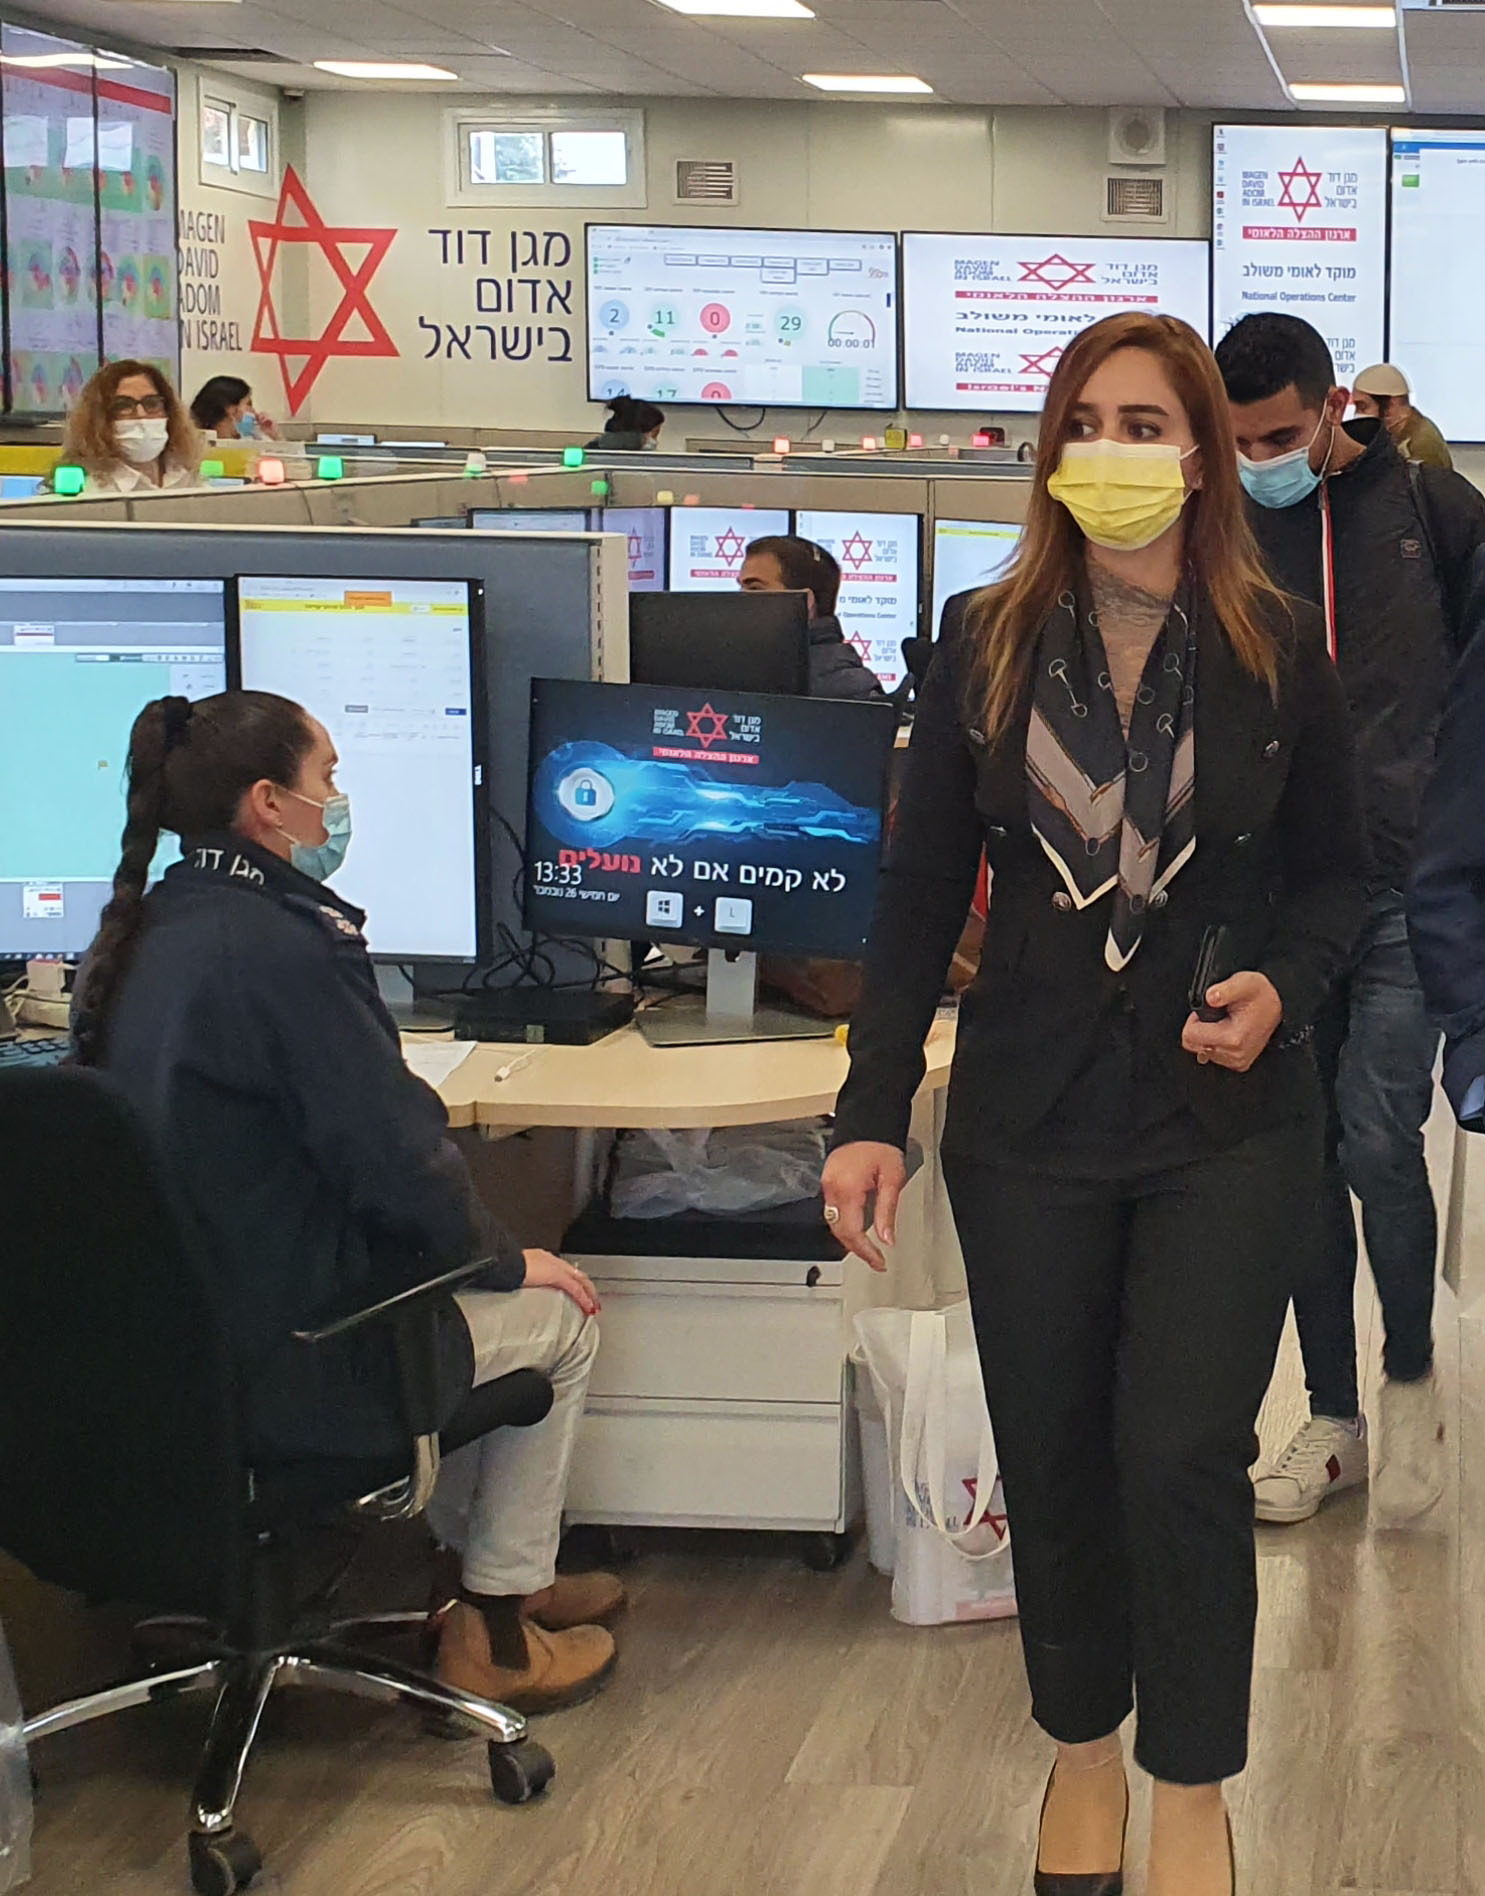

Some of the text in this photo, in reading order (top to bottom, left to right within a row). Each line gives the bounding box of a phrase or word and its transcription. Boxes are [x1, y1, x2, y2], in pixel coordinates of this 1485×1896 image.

[428, 229, 571, 272] מגן דוד
[1242, 262, 1356, 281] מוקד לאומי משולב
[476, 278, 572, 315] אדום
[1242, 291, 1357, 303] National Operations Center
[610, 308, 620, 323] 2
[655, 310, 675, 325] 11
[710, 311, 720, 325] 0
[781, 316, 802, 331] 29
[955, 311, 1029, 322] משולב
[180, 319, 242, 351] N ISRAEL
[956, 326, 1018, 334] National
[418, 315, 573, 363] בישראל
[1336, 363, 1355, 373] בישר
[534, 860, 582, 885] 13:33
[558, 847, 846, 892] לא קמים אם לא נועלים
[533, 884, 620, 902] יום חמישי 26 נובמבר
